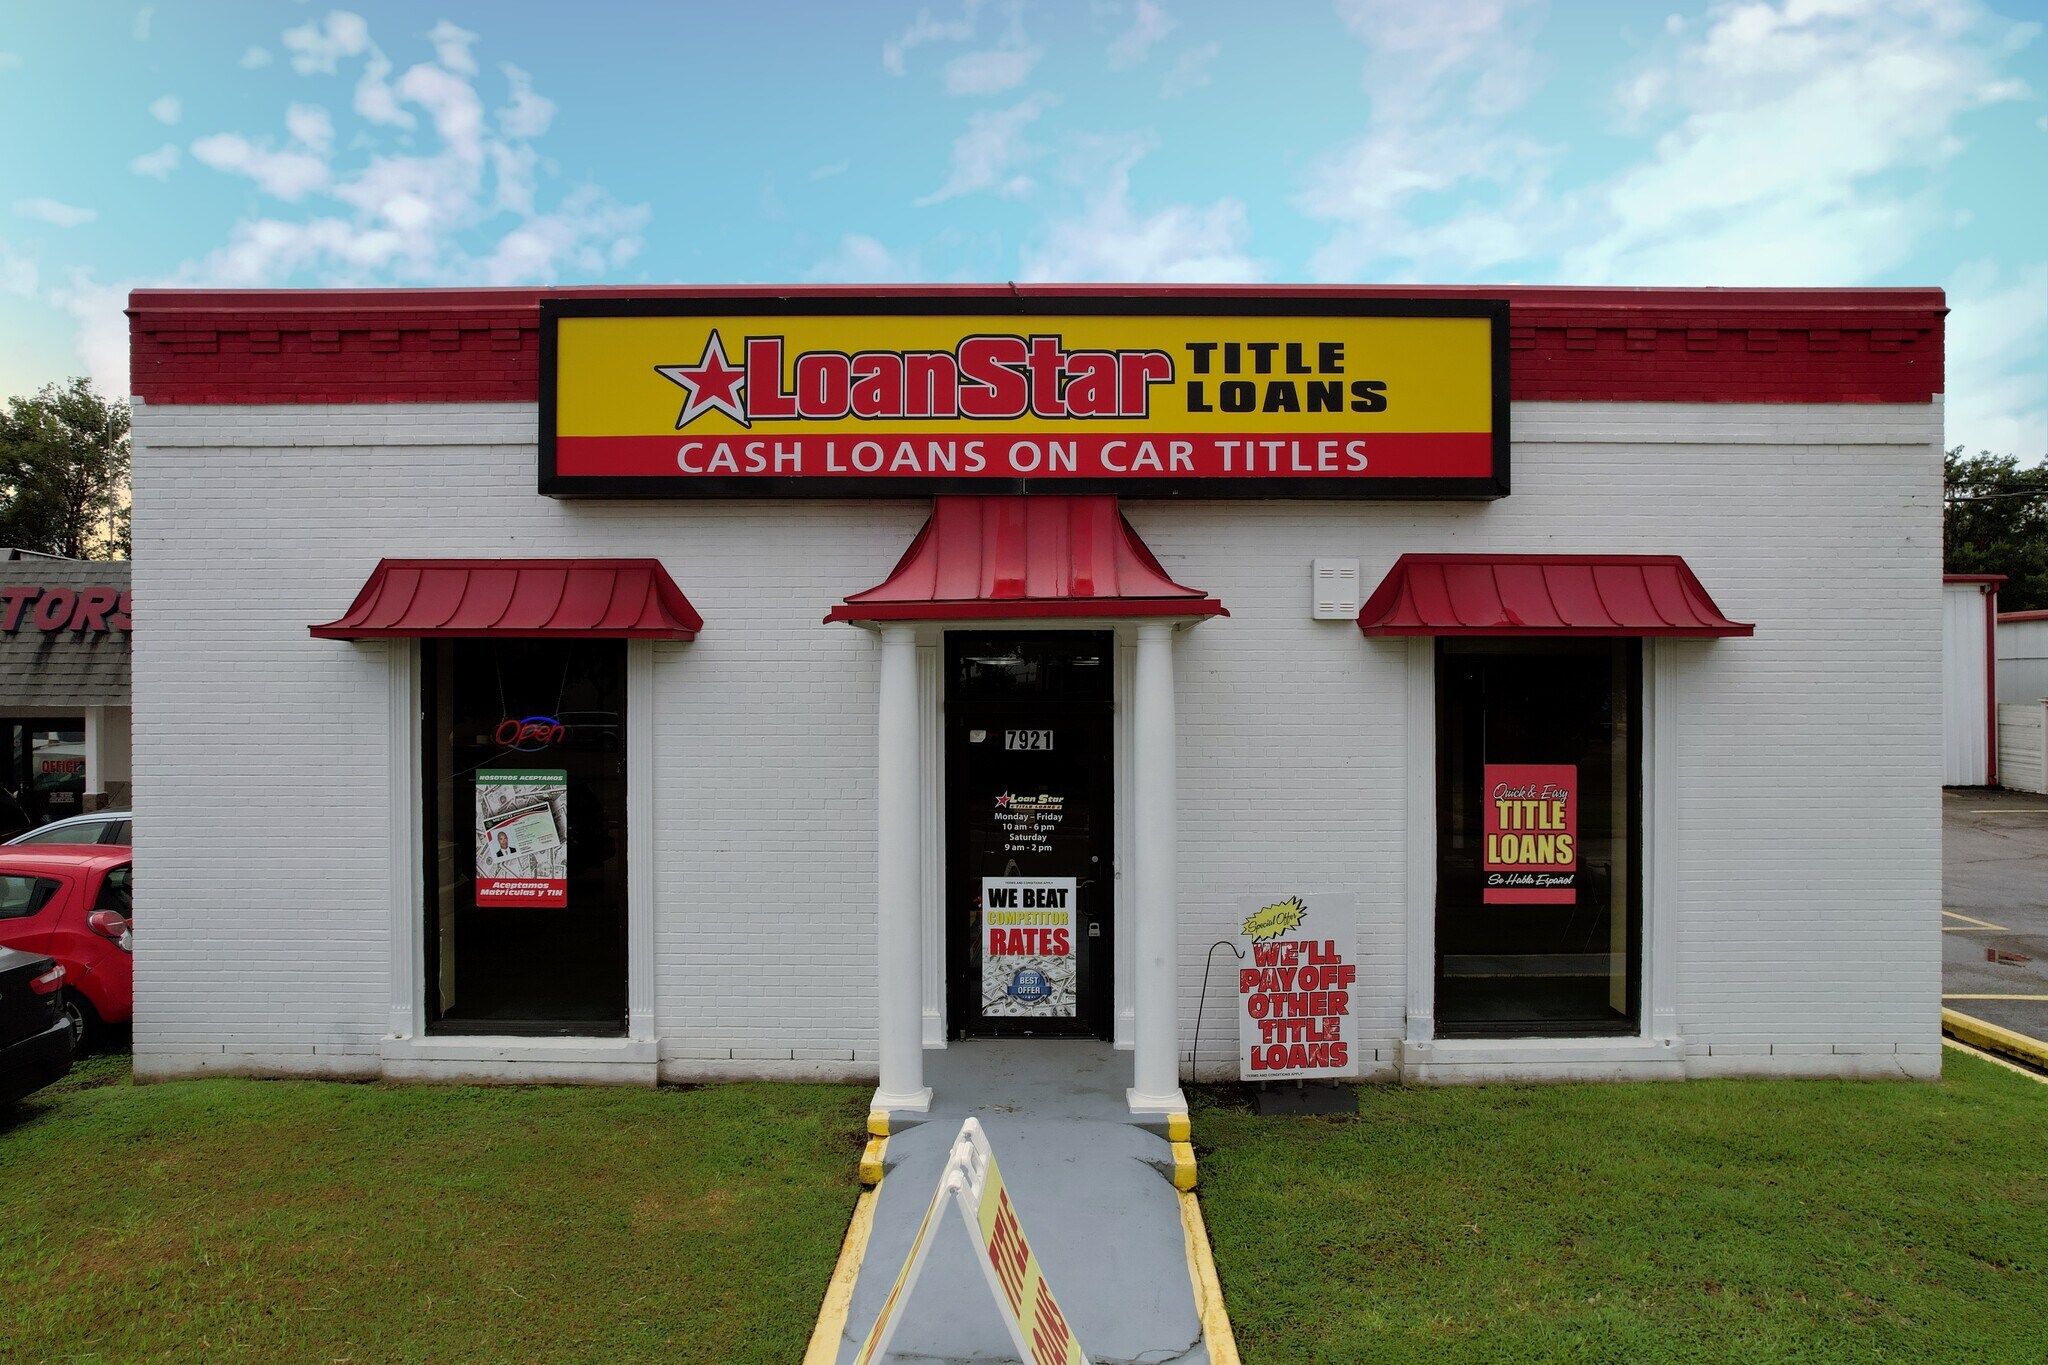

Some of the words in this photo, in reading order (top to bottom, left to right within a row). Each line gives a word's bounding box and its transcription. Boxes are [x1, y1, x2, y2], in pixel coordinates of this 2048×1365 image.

[1186, 342, 1345, 374] TITLE
[744, 334, 1175, 420] LoanStar
[1187, 380, 1388, 413] LOANS
[677, 442, 802, 473] CASH
[826, 441, 987, 472] LOANS
[1008, 441, 1078, 471] ON
[1100, 441, 1195, 471] CAR
[1214, 440, 1369, 471] TITLES
[496, 719, 565, 747] Open
[1007, 730, 1051, 750] 7921
[1493, 782, 1526, 802] Quick
[1527, 784, 1537, 799] &
[1541, 784, 1569, 804] Easy
[994, 812, 1029, 822] Monday
[1036, 812, 1063, 823] Friday
[1496, 799, 1567, 830] TITLE
[1002, 823, 1013, 831] 10
[1034, 823, 1039, 831] 6
[1040, 824, 1055, 832] pm
[1009, 833, 1047, 843] Saturday
[1004, 843, 1010, 851] 9
[1031, 843, 1037, 851] 2
[1038, 845, 1052, 853] pm
[1488, 833, 1574, 865] LOANS
[492, 881, 550, 889] Aceptamos
[1505, 873, 1535, 886] Habla
[1535, 874, 1575, 888] Español
[537, 889, 545, 897] y
[988, 888, 1018, 908] WE
[1023, 888, 1069, 908] BEAT
[987, 911, 1069, 926] COMPETITOR
[1247, 915, 1276, 933] Special
[1276, 911, 1297, 926] Offer
[990, 928, 1070, 957] RATES
[1253, 940, 1342, 967] WE'LL
[1017, 985, 1041, 994] OFFER
[1019, 976, 1039, 985] BEST
[1248, 991, 1349, 1019] OTHER
[1258, 1017, 1340, 1044] TITLE
[1251, 1042, 1348, 1070] LOANS
[989, 1186, 1029, 1321] TITLE
[1031, 1276, 1069, 1365] OANS
